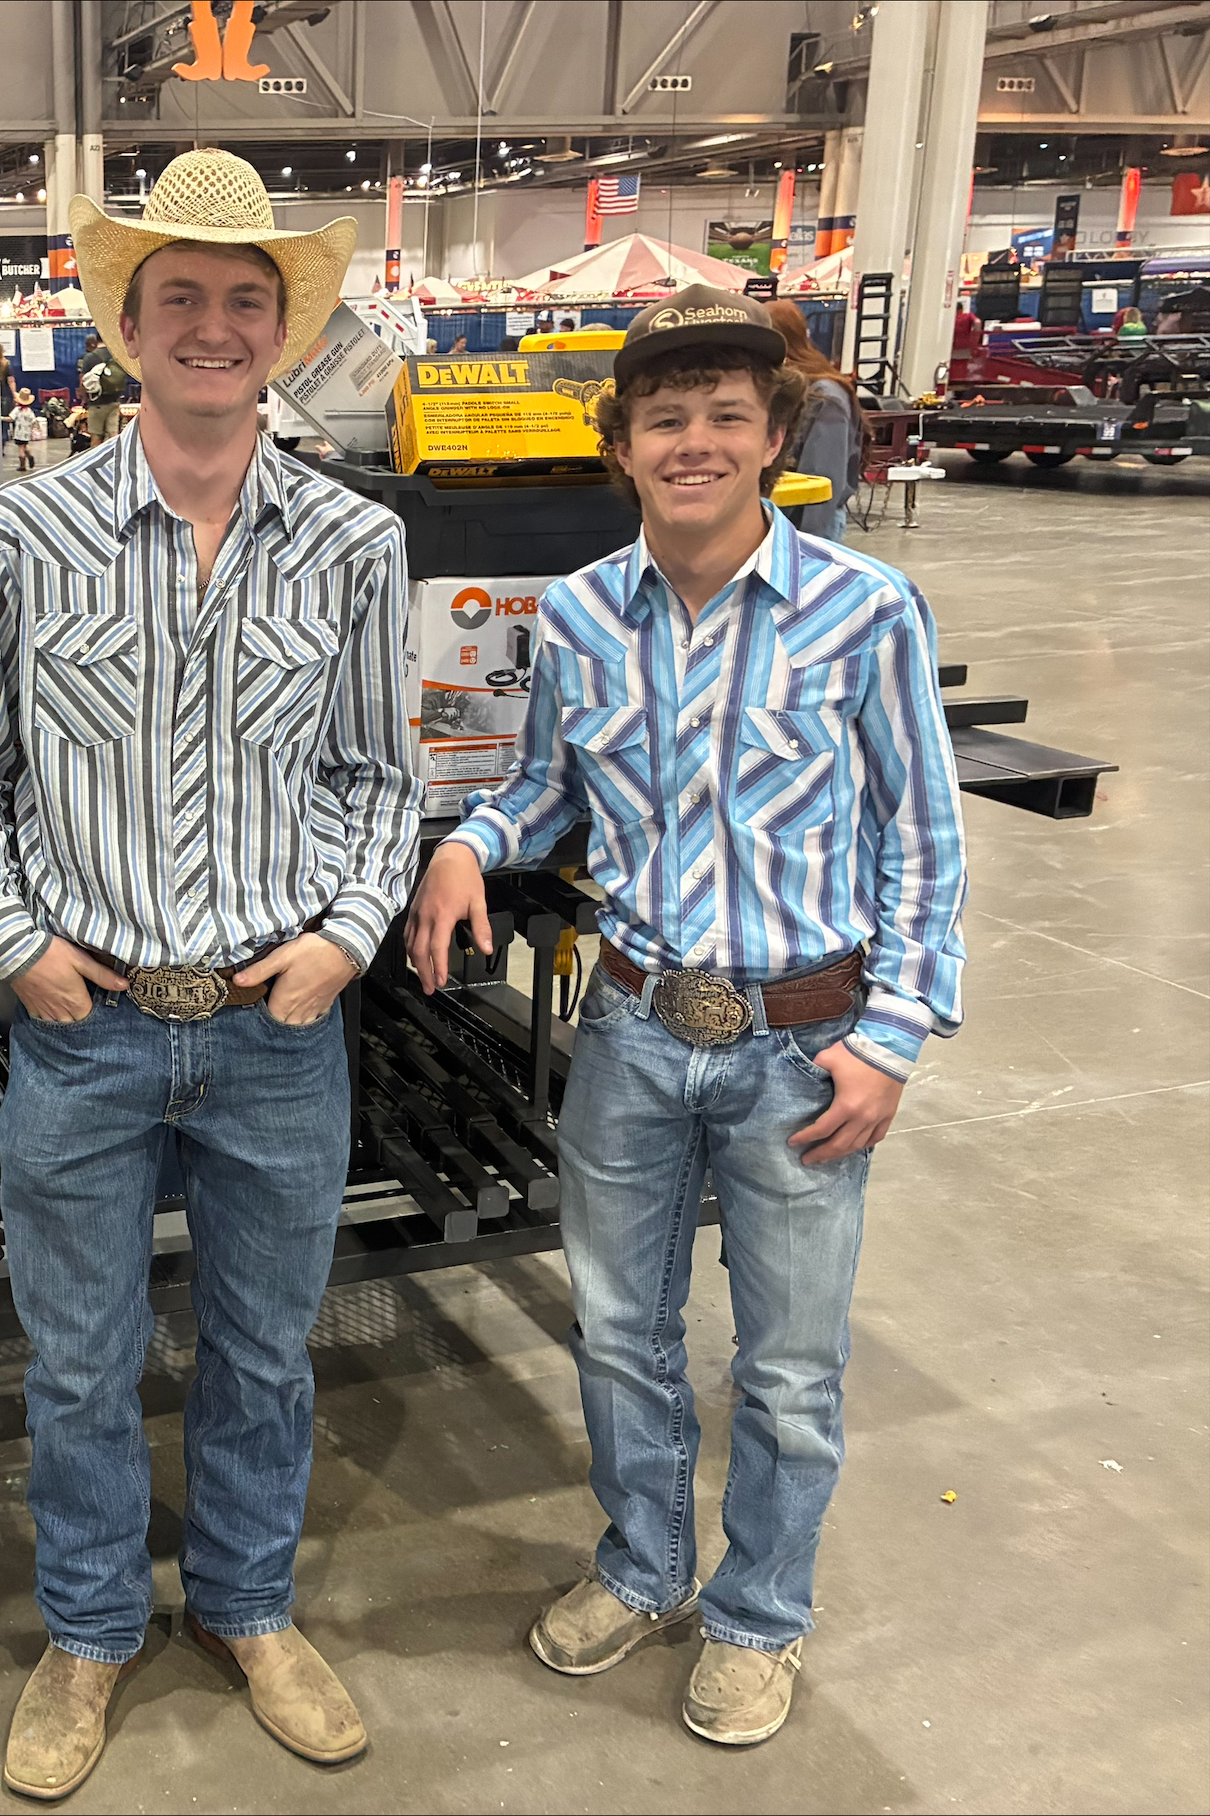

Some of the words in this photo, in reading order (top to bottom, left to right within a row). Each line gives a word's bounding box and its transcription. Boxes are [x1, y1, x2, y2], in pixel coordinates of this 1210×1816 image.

[2, 264, 40, 276] BUTCHER
[294, 374, 313, 398] PISTOL
[312, 354, 332, 378] GREASE
[331, 341, 343, 357] GUN
[300, 378, 322, 403] PISTOLET
[325, 352, 346, 376] GRAISSE
[344, 328, 366, 353] PISTOLET
[418, 362, 530, 386] DEWALT
